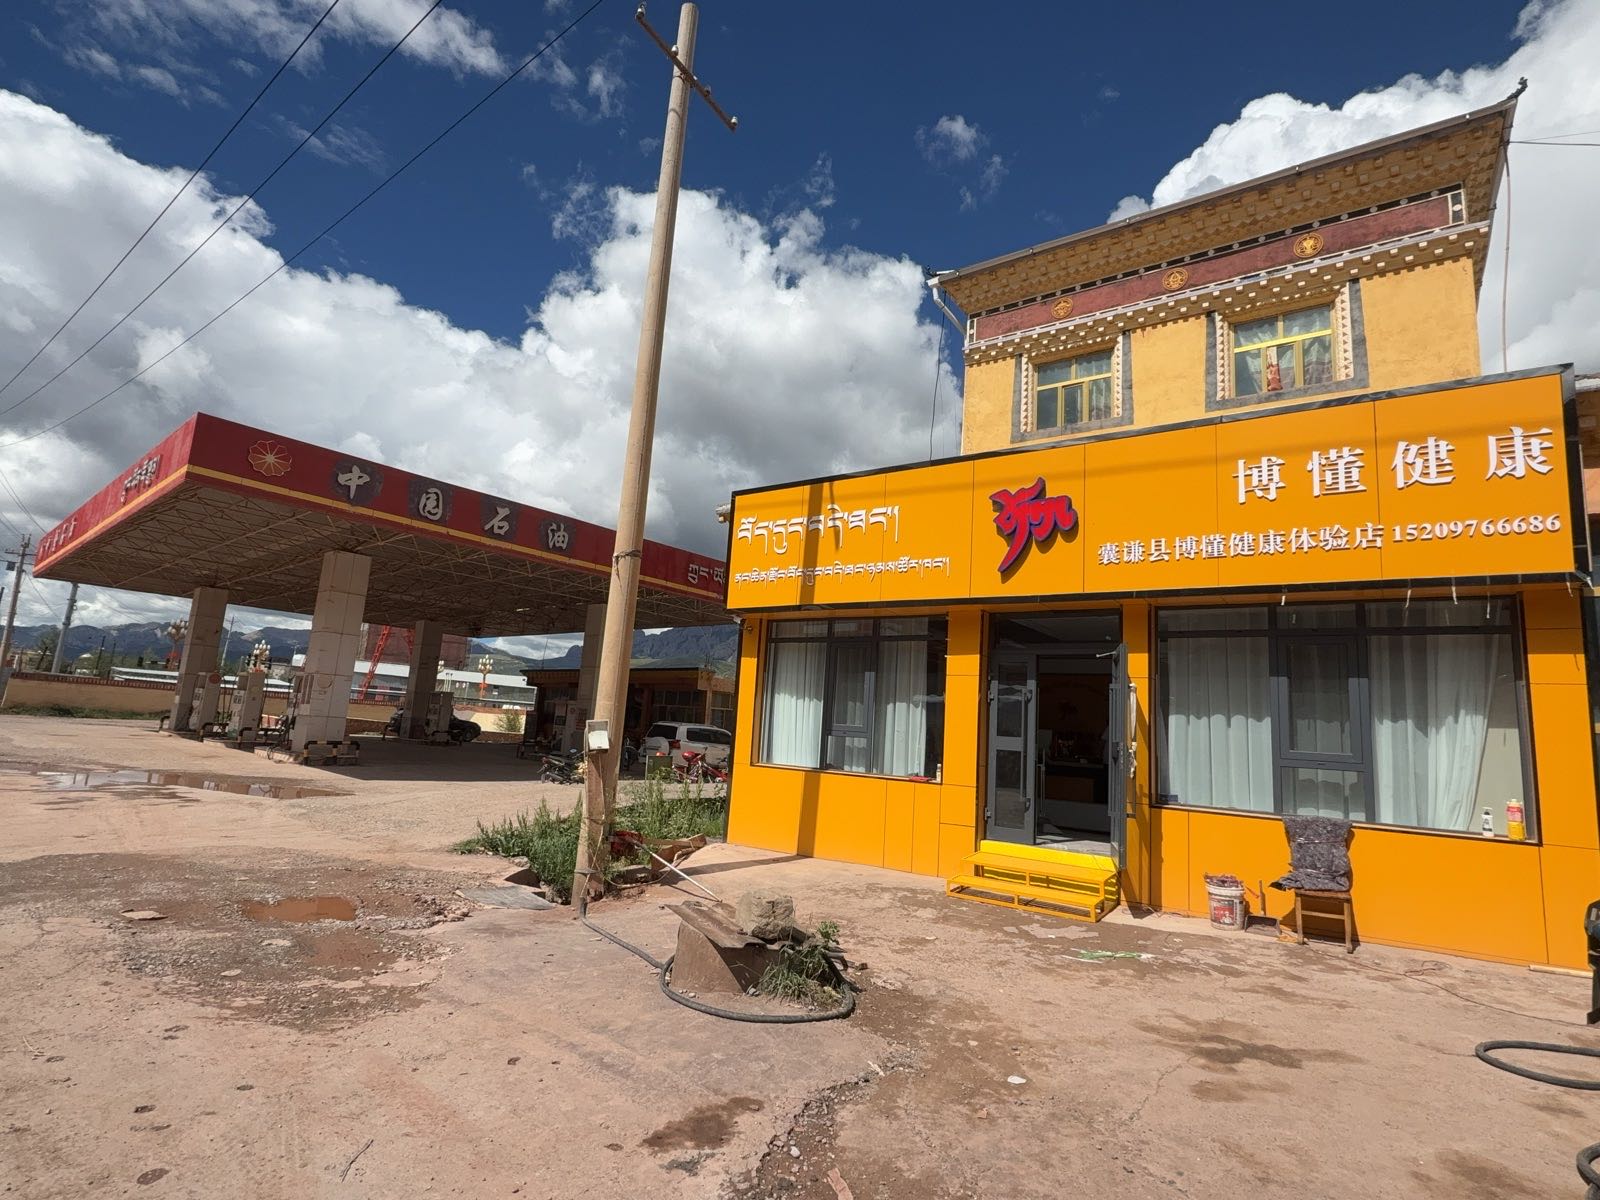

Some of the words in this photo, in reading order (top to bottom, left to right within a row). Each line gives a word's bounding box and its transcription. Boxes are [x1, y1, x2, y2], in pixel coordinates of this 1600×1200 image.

[1232, 426, 1554, 505] 博懂健康
[337, 465, 569, 550] 中国石油
[1098, 522, 1384, 566] 囊谦县博懂健康体验店
[1392, 513, 1562, 543] 15209766686
